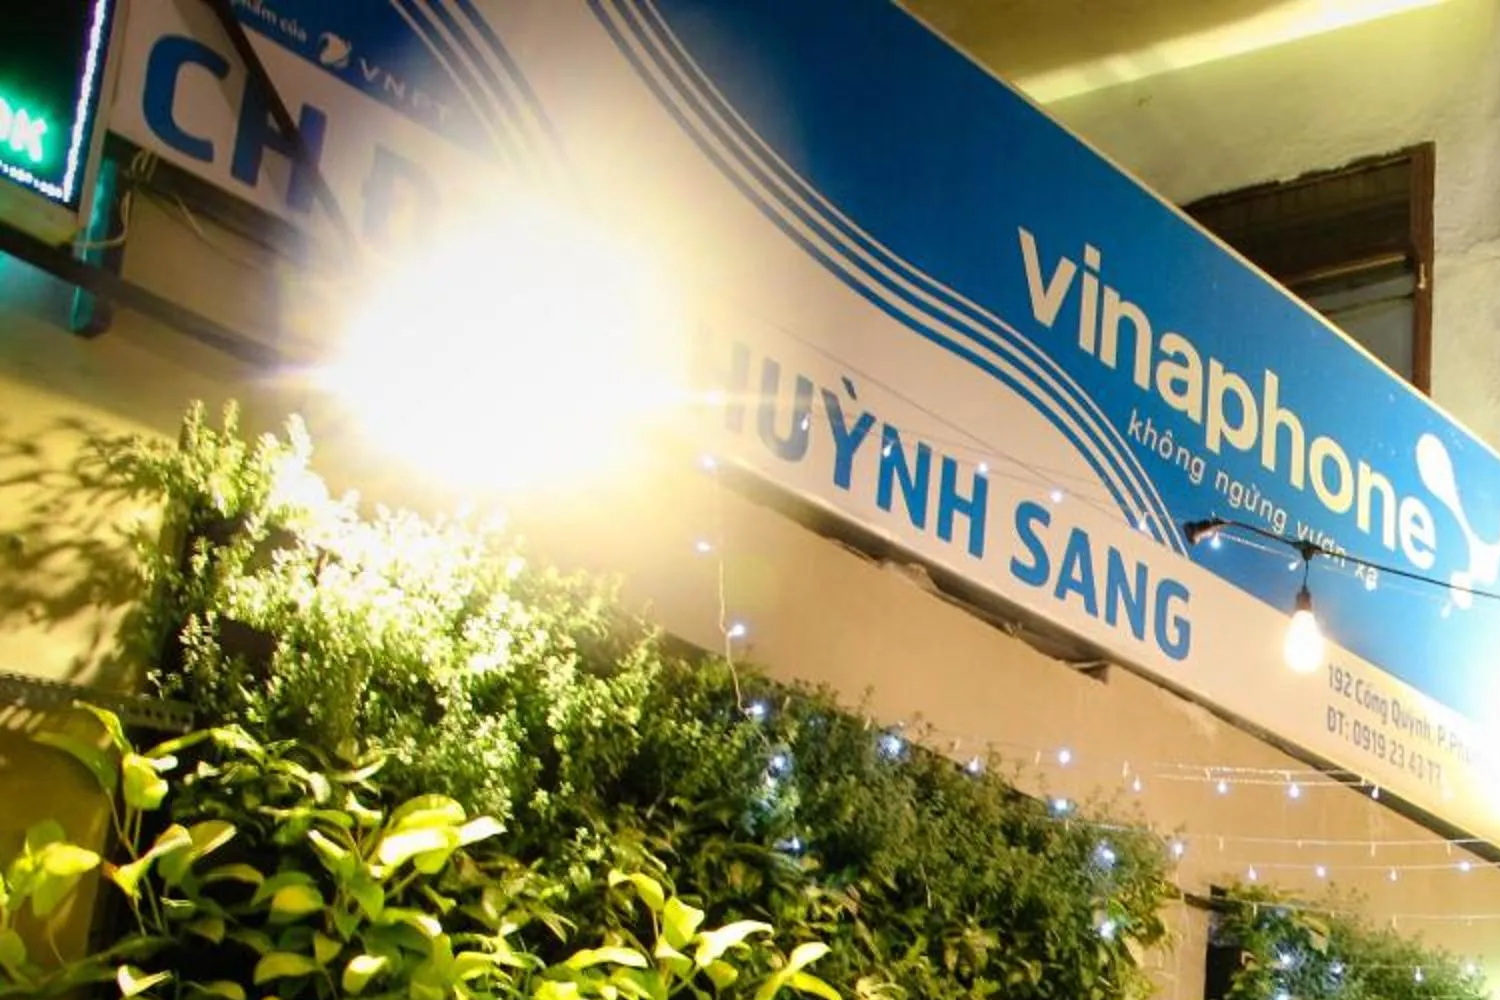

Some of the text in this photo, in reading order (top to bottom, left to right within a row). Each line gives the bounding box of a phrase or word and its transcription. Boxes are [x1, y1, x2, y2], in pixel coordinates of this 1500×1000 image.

[1017, 226, 1437, 570] vinaphone
[1127, 409, 1206, 484] không
[1215, 469, 1287, 535] ngừng
[1010, 500, 1193, 661] SANG
[1328, 663, 1352, 698] 192
[1353, 719, 1387, 759] 0919
[1389, 739, 1405, 769] 23
